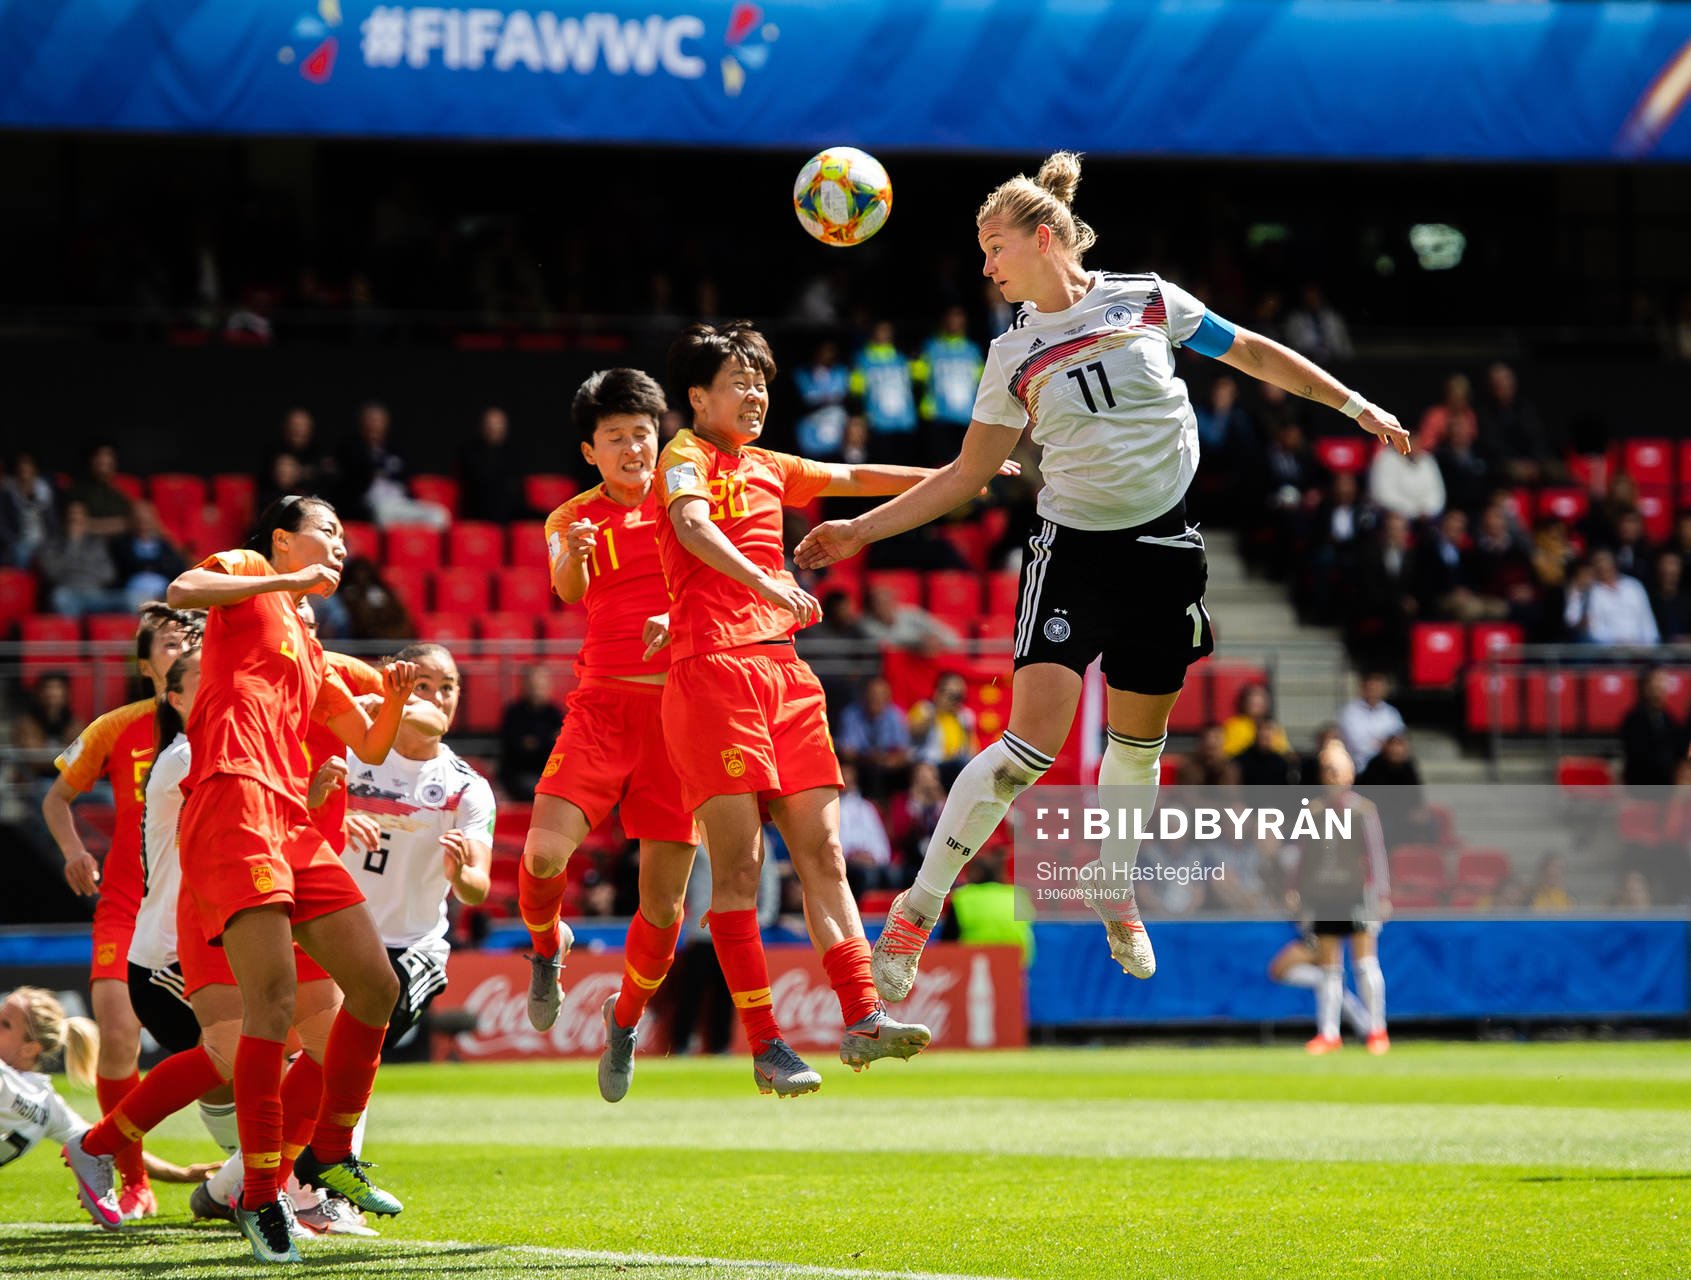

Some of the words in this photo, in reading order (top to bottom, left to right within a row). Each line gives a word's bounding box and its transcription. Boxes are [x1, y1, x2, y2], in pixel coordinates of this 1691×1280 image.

[361, 5, 706, 79] #FIFAWWC
[1066, 361, 1117, 413] 11
[708, 474, 751, 520] 20
[946, 836, 971, 857] DFB
[454, 973, 657, 1055] CocCo
